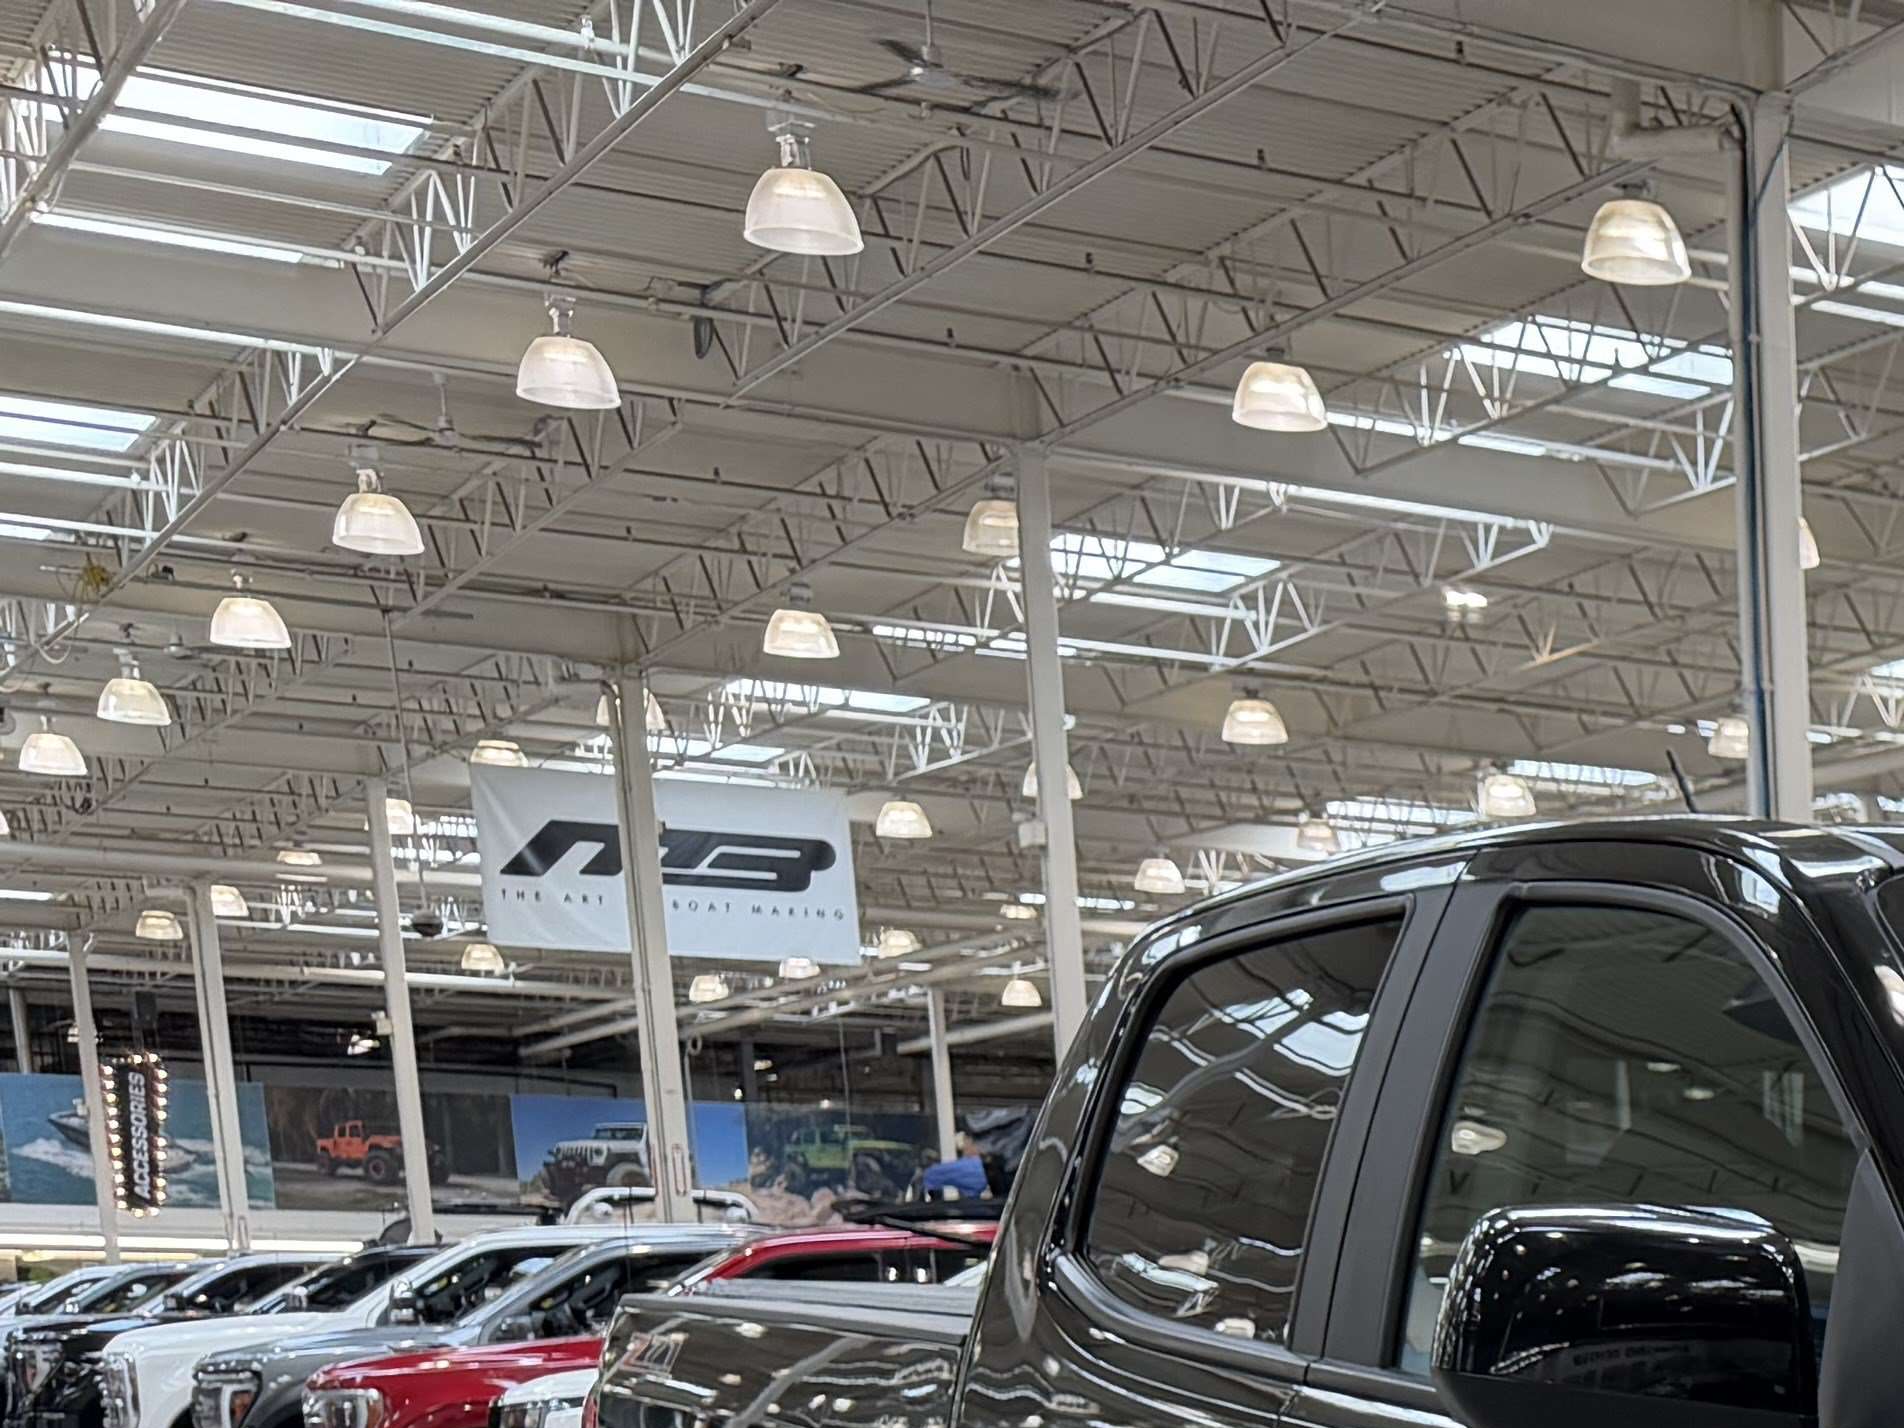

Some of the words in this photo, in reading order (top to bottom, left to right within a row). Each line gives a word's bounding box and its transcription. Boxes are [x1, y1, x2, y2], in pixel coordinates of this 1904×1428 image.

[500, 887, 541, 902] THE
[563, 893, 605, 906] ART
[671, 900, 732, 914] BOAT
[751, 904, 845, 921] MAKING
[128, 1071, 151, 1200] ACCESSORIES
